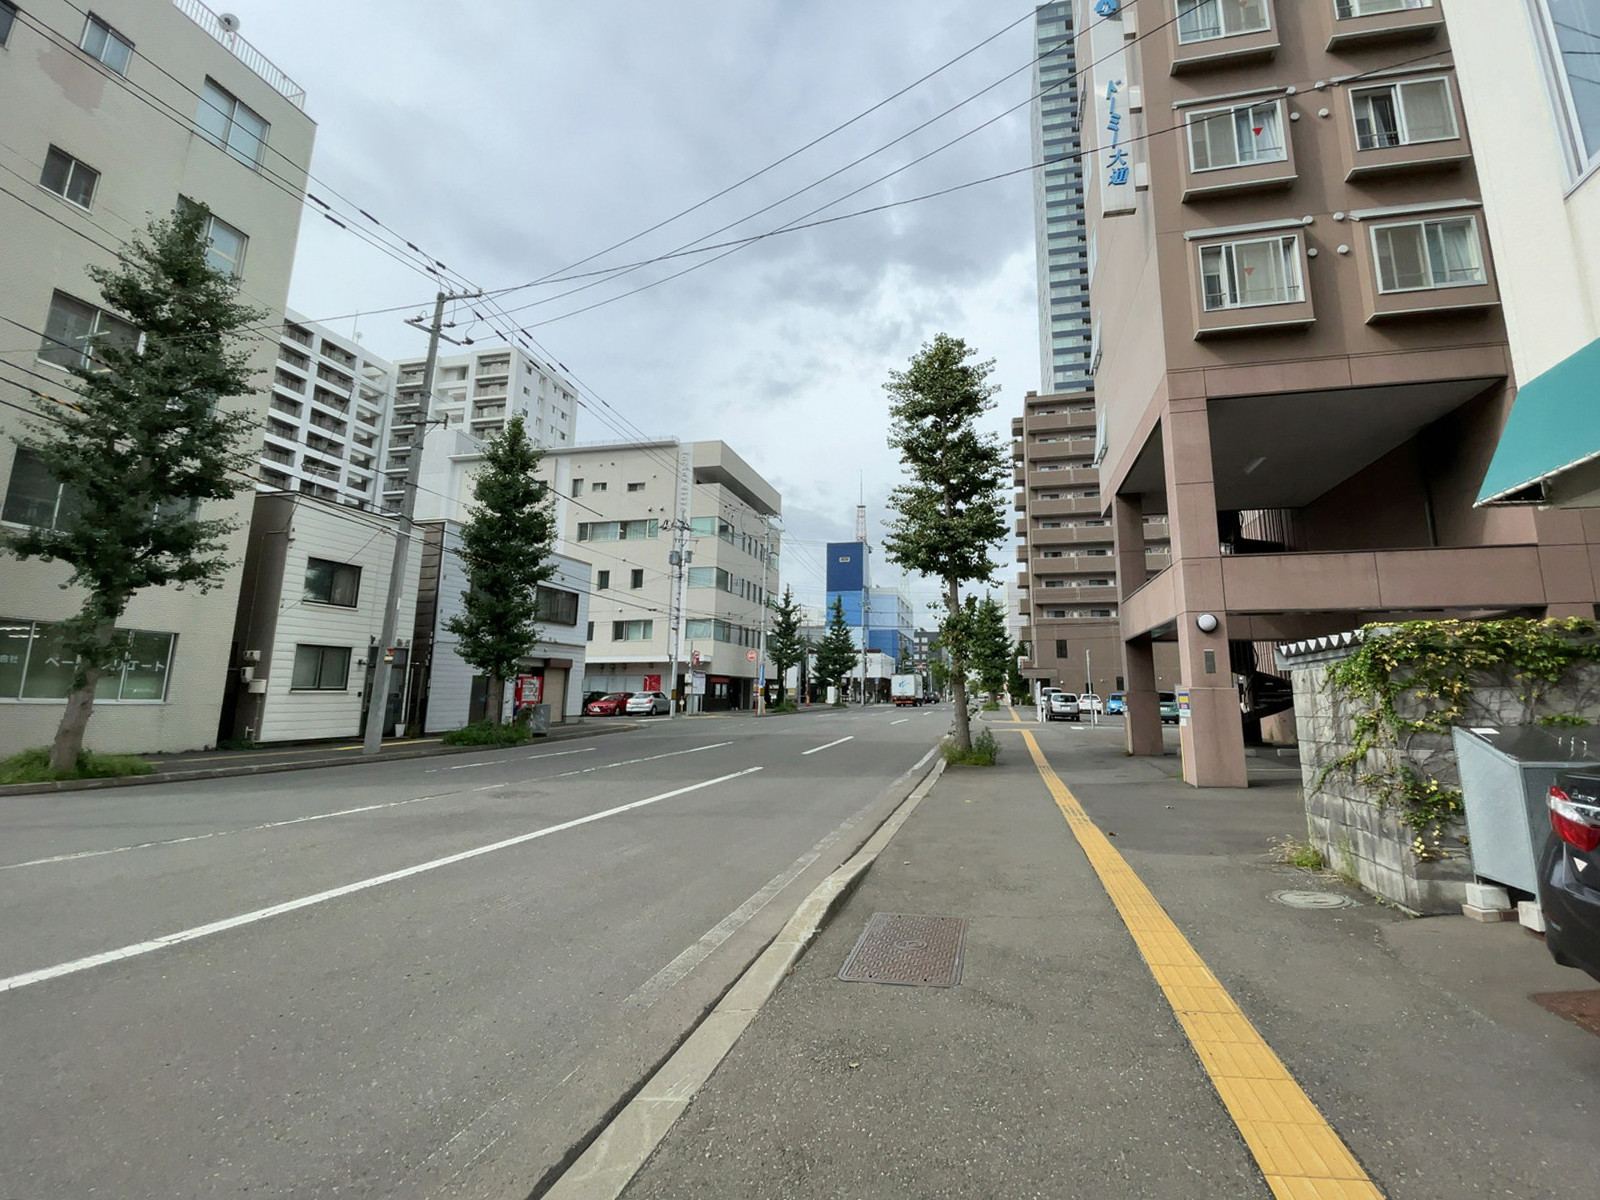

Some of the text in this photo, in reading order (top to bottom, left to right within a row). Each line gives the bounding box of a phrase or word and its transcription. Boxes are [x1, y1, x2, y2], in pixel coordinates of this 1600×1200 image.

[1106, 79, 1130, 187] ドーミー大通
